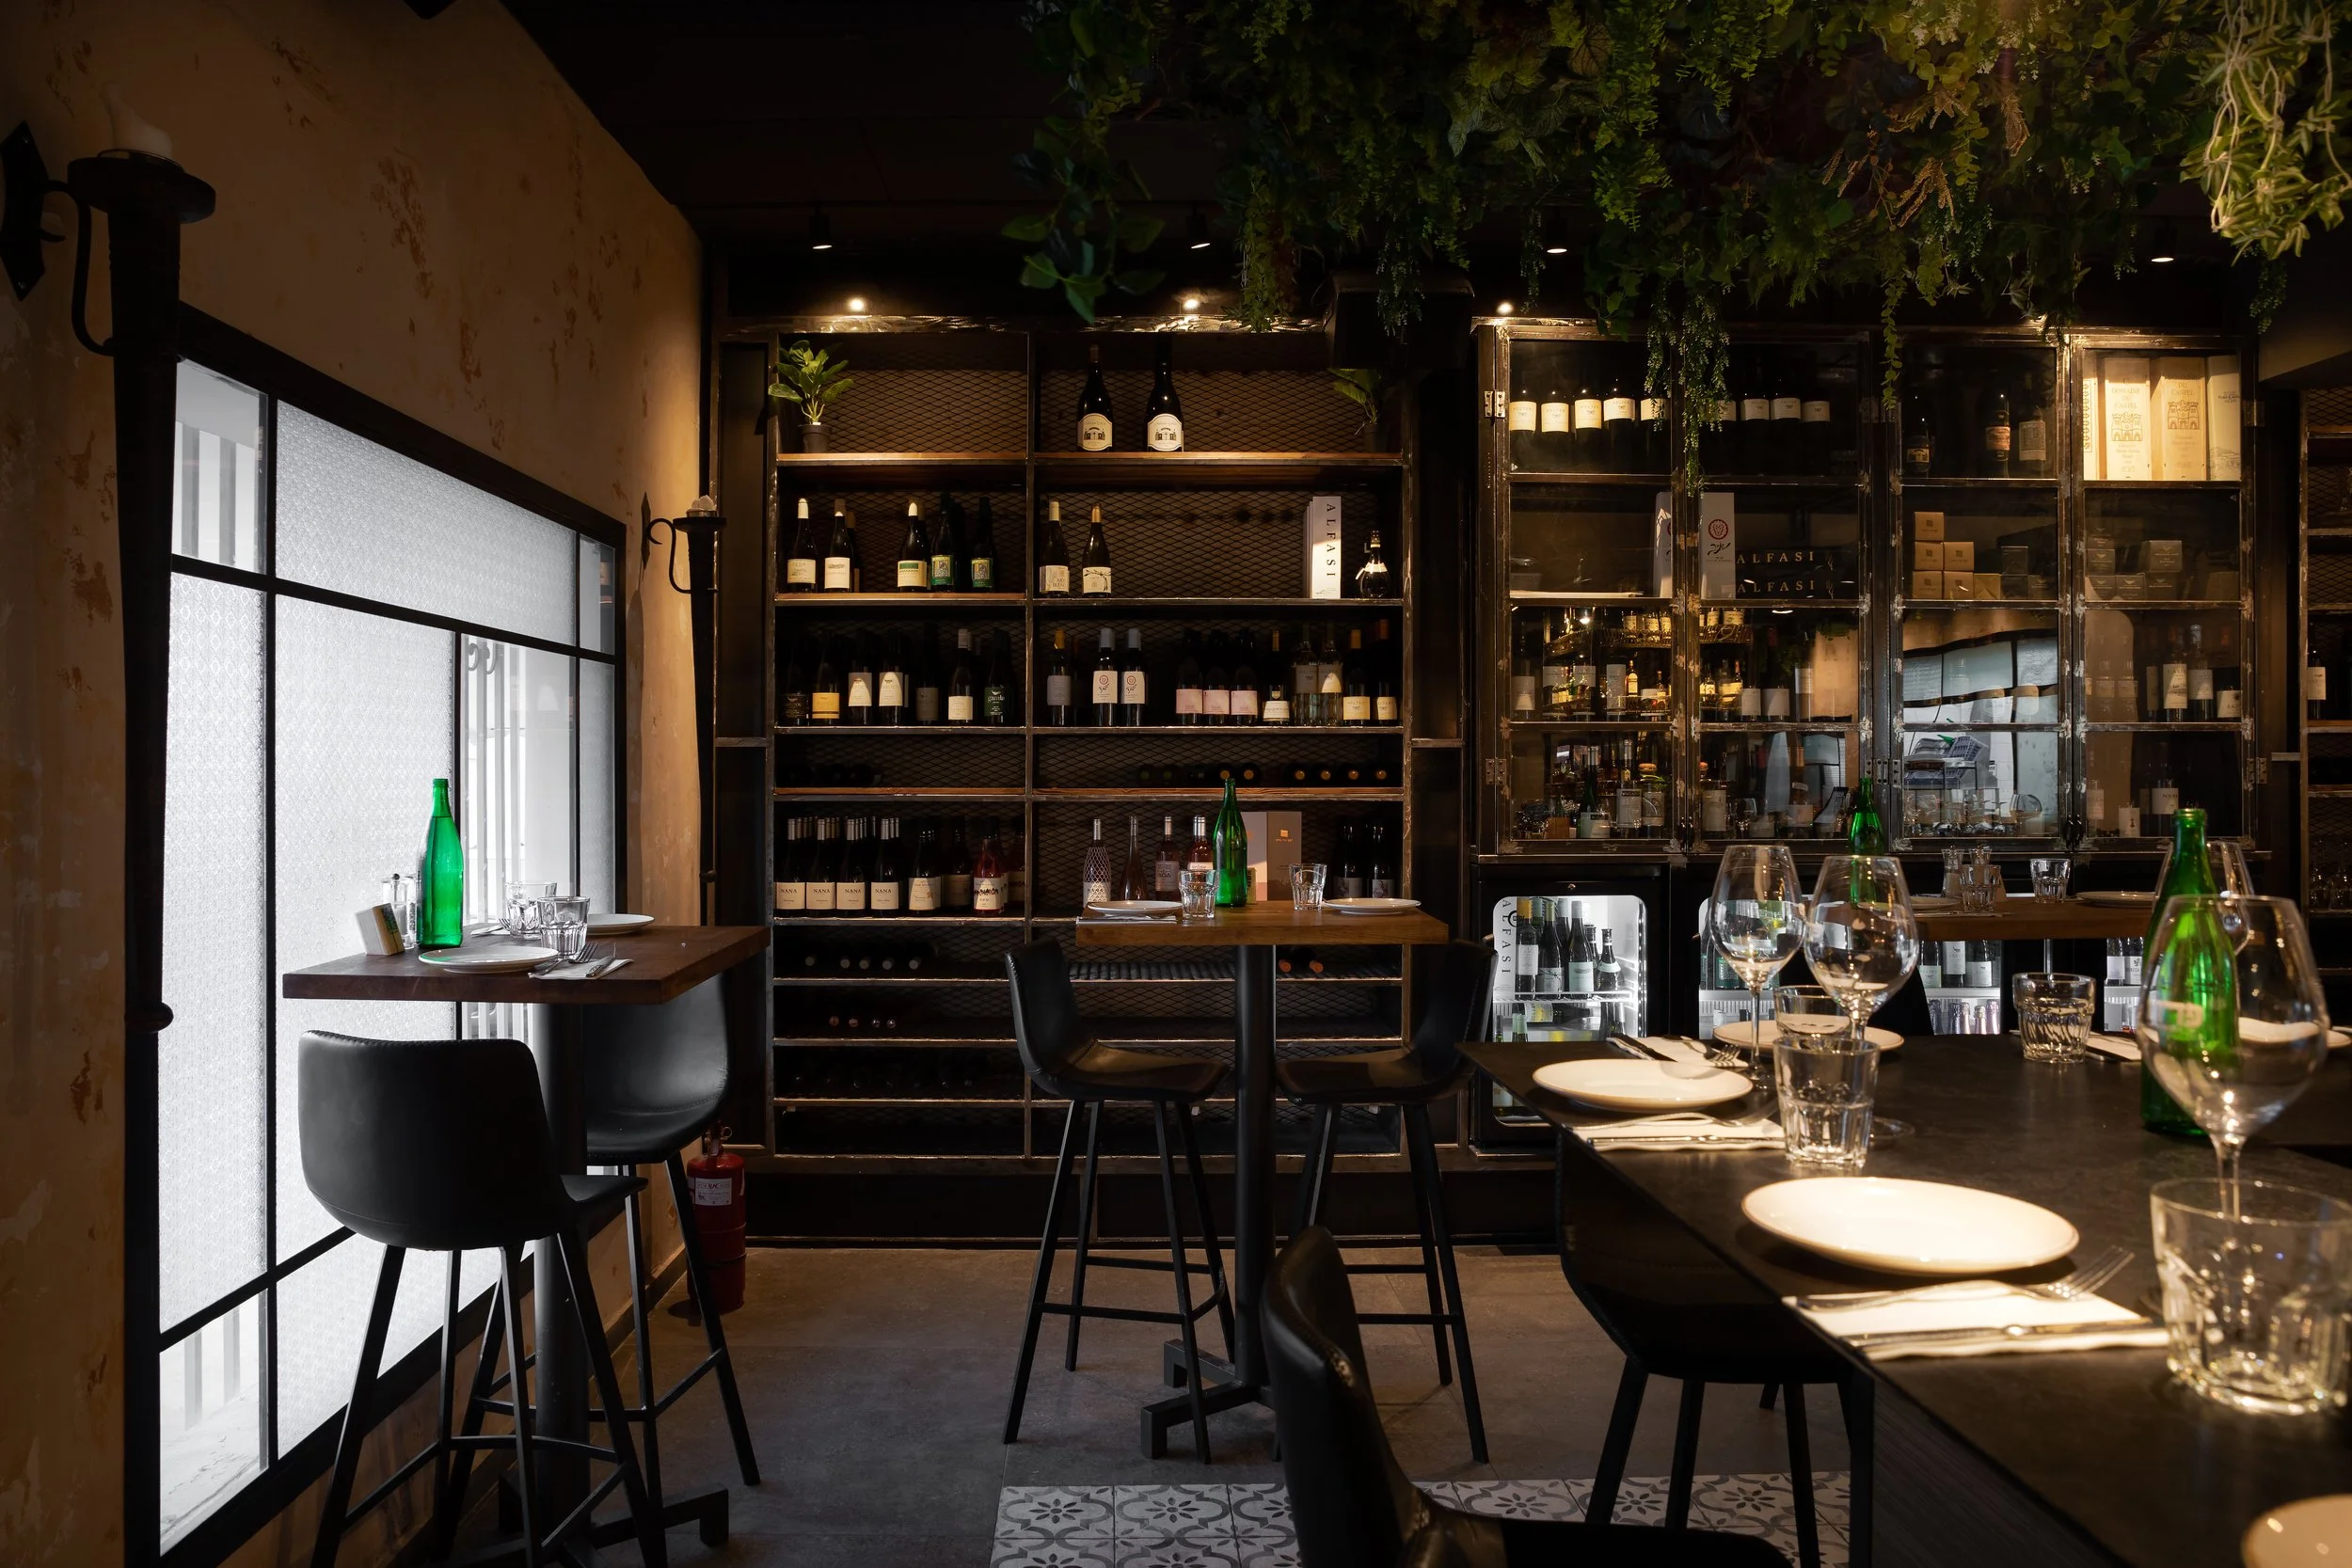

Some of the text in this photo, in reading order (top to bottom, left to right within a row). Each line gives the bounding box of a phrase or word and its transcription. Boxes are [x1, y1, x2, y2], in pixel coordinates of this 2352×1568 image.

[1327, 503, 1336, 576] ALFASI
[1736, 551, 1814, 564] ALFASI
[1737, 579, 1815, 594] ALFASI
[1502, 899, 1511, 974] ALFASI
